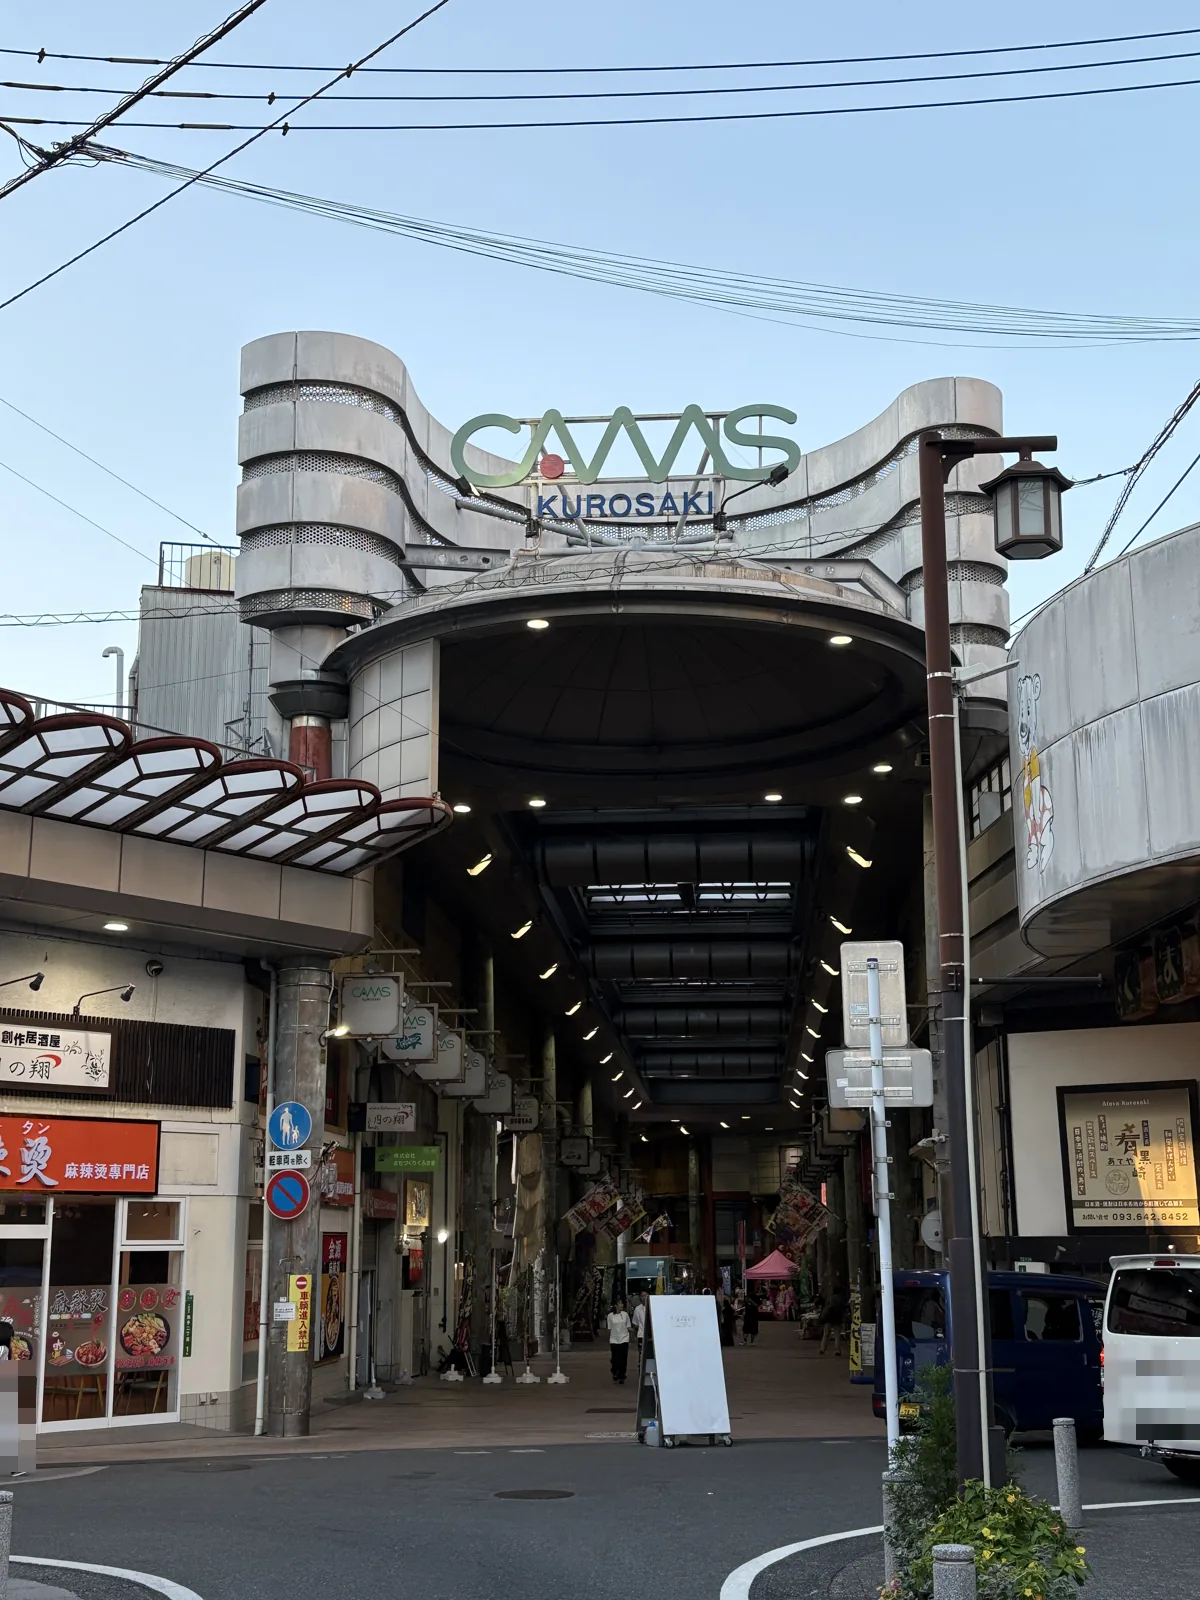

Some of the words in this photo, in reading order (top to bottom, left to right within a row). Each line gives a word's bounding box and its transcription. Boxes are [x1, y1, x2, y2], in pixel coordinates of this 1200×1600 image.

[450, 404, 801, 488] CAMS
[537, 491, 713, 518] KUROSAKI
[352, 986, 391, 998] CAMS
[2, 1030, 61, 1048] 創作居酒屋
[0, 1056, 51, 1080] の翔
[374, 1114, 405, 1125] 月の翔
[269, 1154, 308, 1166] 軽車両を除く
[1108, 1157, 1134, 1166] あてや
[1112, 1213, 1189, 1221] 093.642.8452
